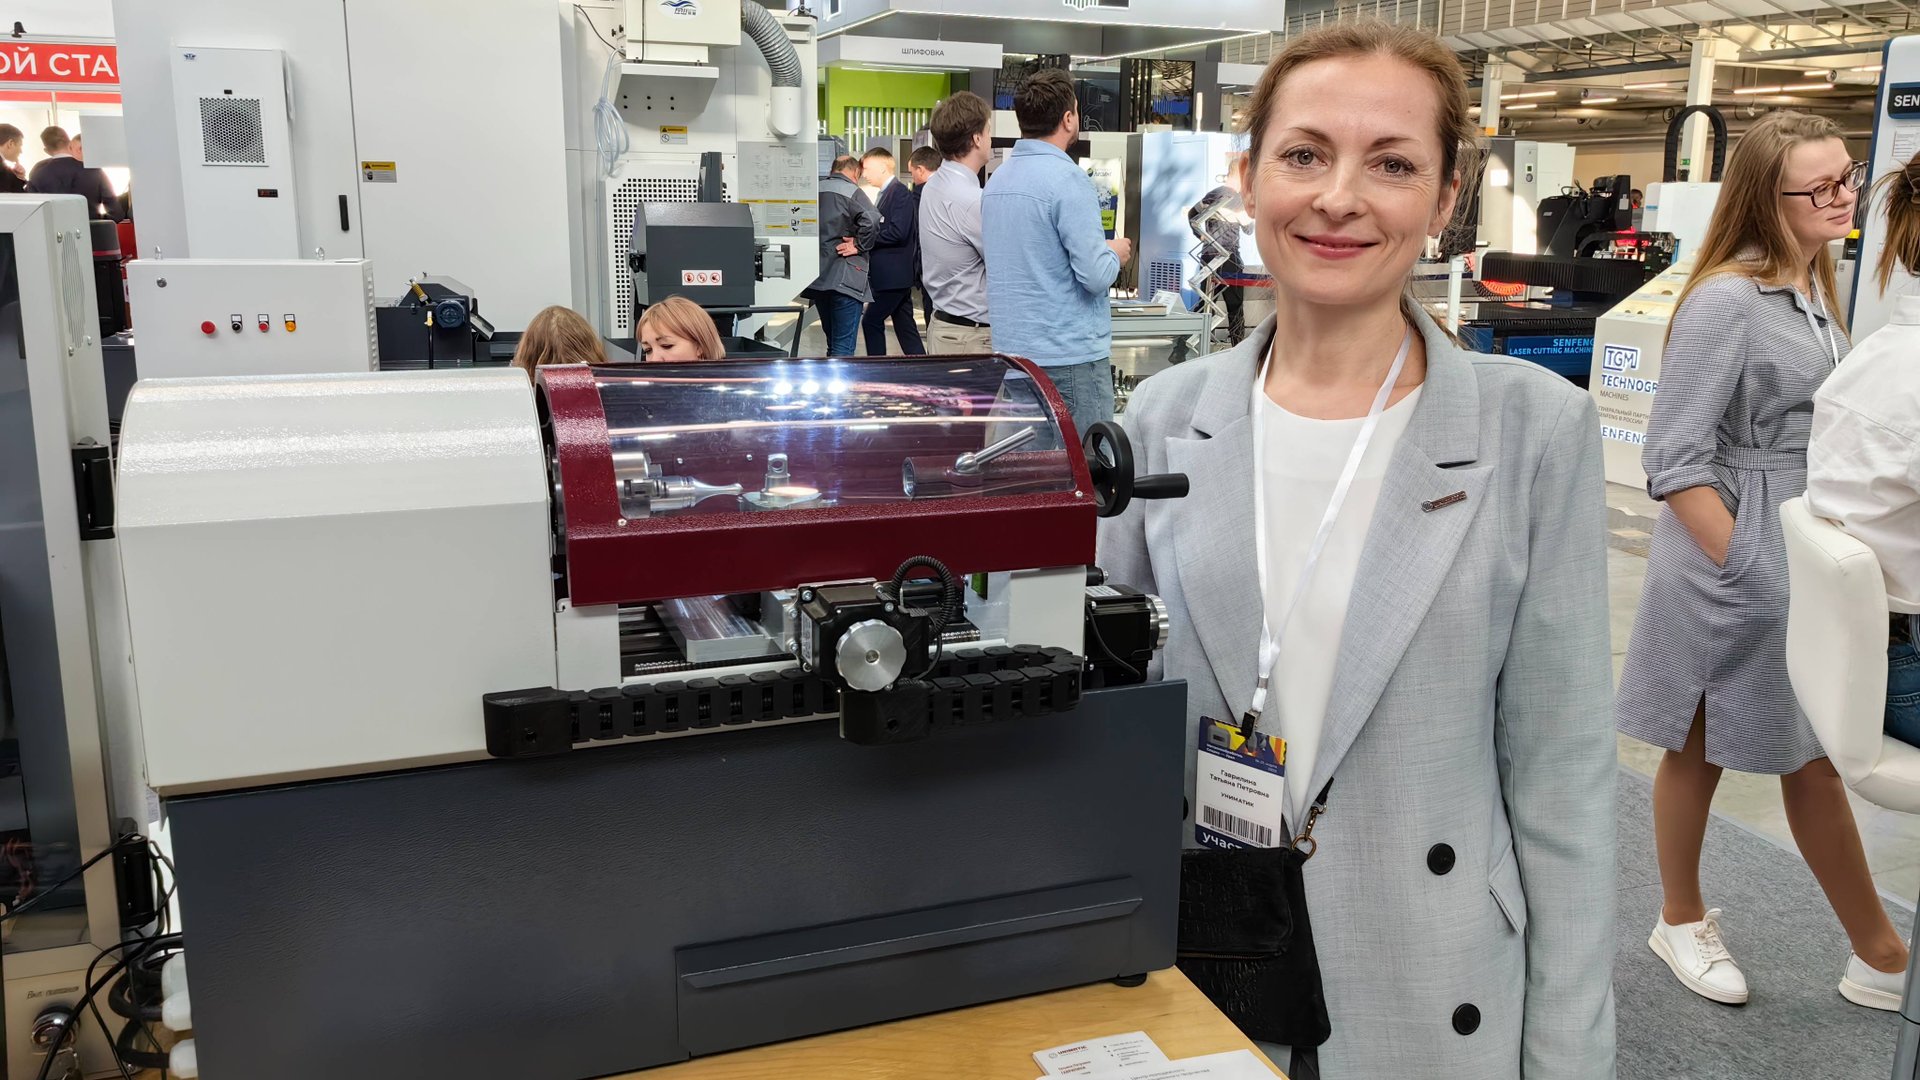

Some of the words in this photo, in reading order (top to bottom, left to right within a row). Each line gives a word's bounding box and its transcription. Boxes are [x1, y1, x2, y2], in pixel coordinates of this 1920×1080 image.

[901, 47, 945, 57] ШЛИФОВКА
[1509, 347, 1531, 355] LASER
[1606, 349, 1637, 370] TGM
[1600, 390, 1629, 401] MACHINES
[1623, 417, 1643, 425] РОССИИ
[1220, 769, 1257, 786] Гаврилина
[1209, 773, 1236, 787] Татьяна
[1236, 783, 1270, 799] Петровна
[1220, 791, 1255, 807] УНИМАТИК
